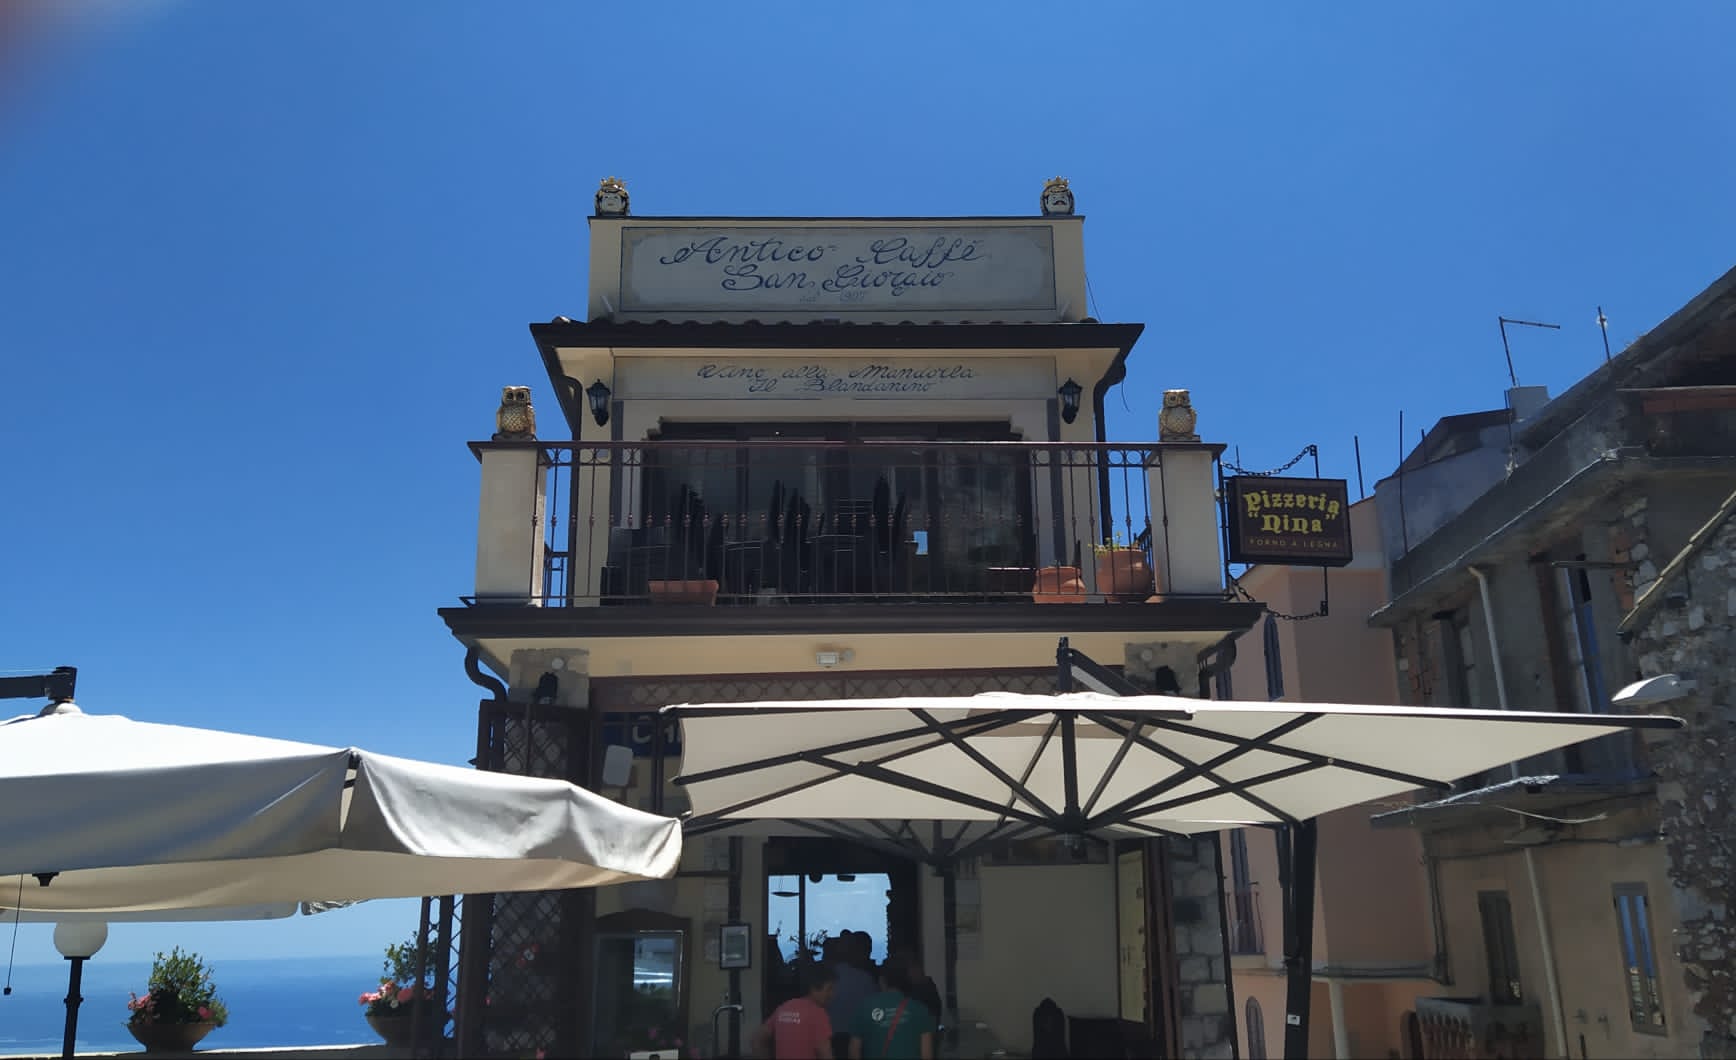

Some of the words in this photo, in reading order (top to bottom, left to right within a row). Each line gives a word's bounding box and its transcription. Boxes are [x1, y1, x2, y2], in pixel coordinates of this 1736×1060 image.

[660, 236, 828, 265] Antico
[856, 236, 985, 268] Caffè
[721, 263, 816, 291] San
[822, 264, 954, 297] Giorgio
[782, 364, 831, 379] alla
[848, 364, 978, 379] Mandorla
[1243, 490, 1341, 515] Pizzeria
[1248, 537, 1287, 547] FORNO
